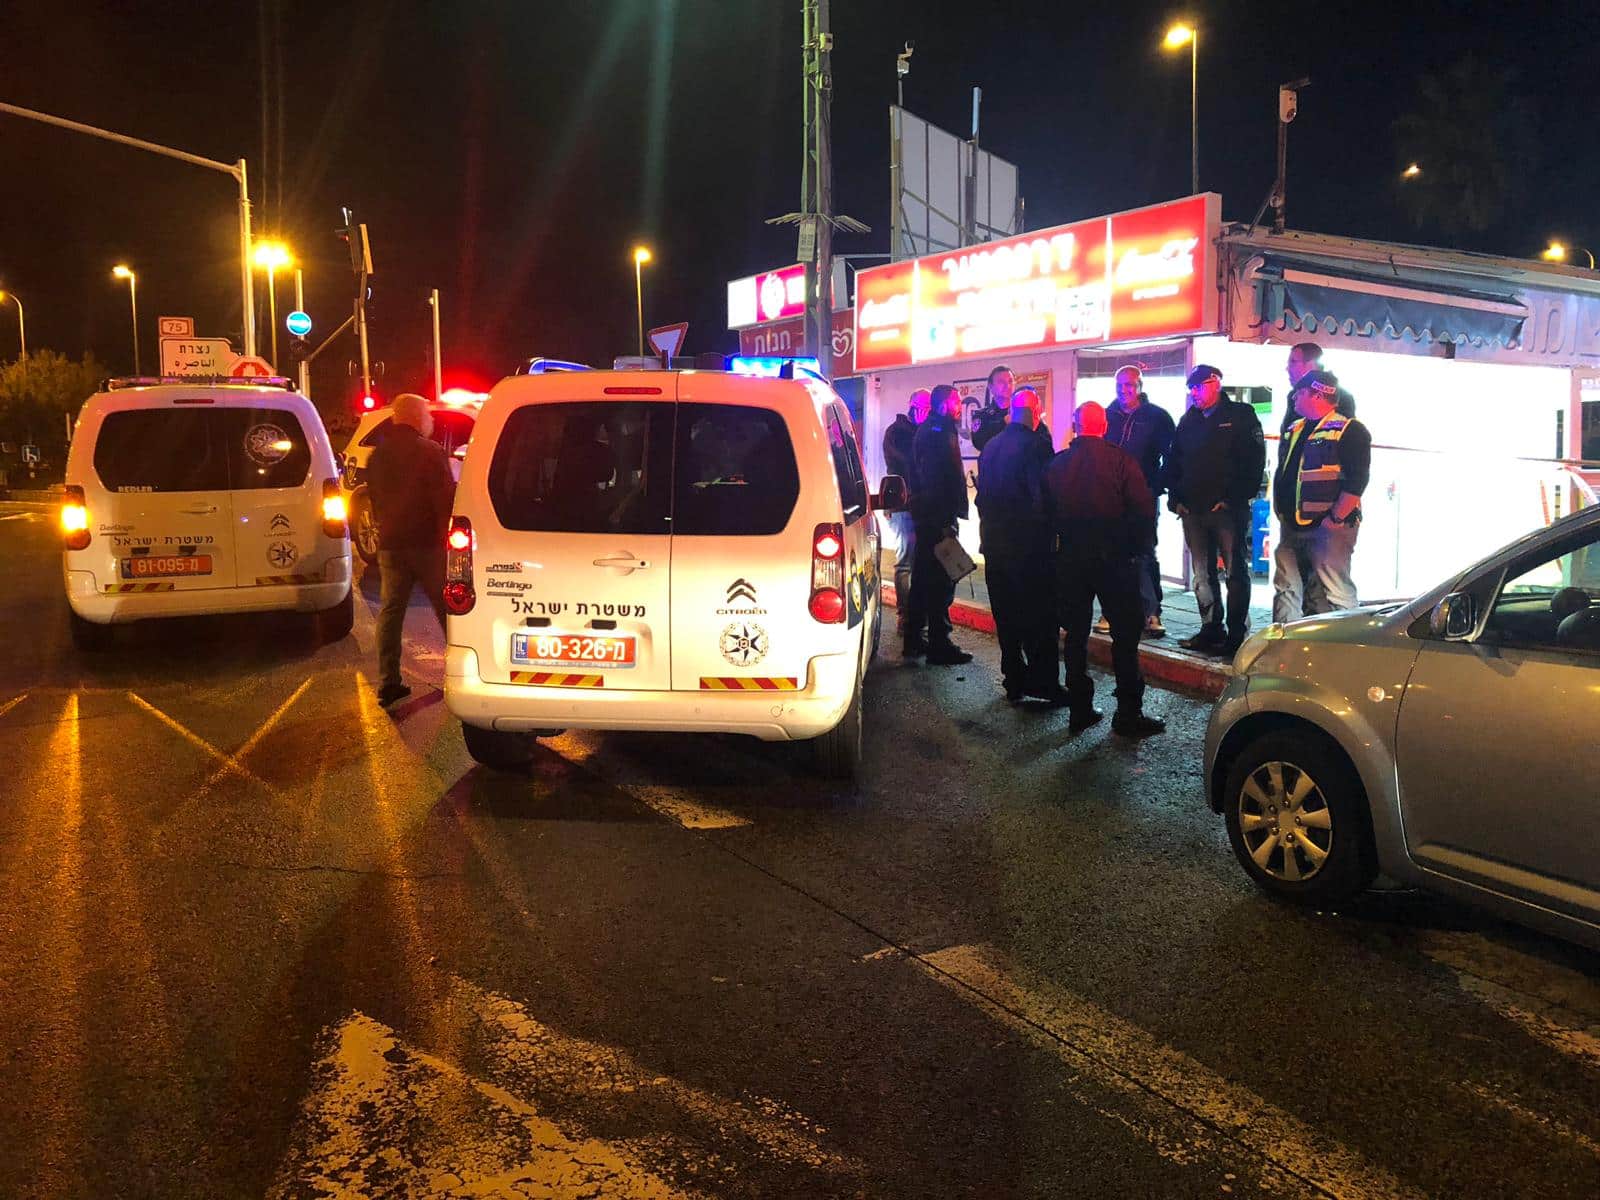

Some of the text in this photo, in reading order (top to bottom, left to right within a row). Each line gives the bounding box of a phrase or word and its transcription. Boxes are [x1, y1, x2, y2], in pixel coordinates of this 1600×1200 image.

[168, 322, 183, 332] 75
[179, 344, 211, 354] נצרת
[114, 535, 215, 546] משטרת ישראל
[487, 578, 532, 591] Berlingo
[511, 598, 646, 618] משטרת ישראל
